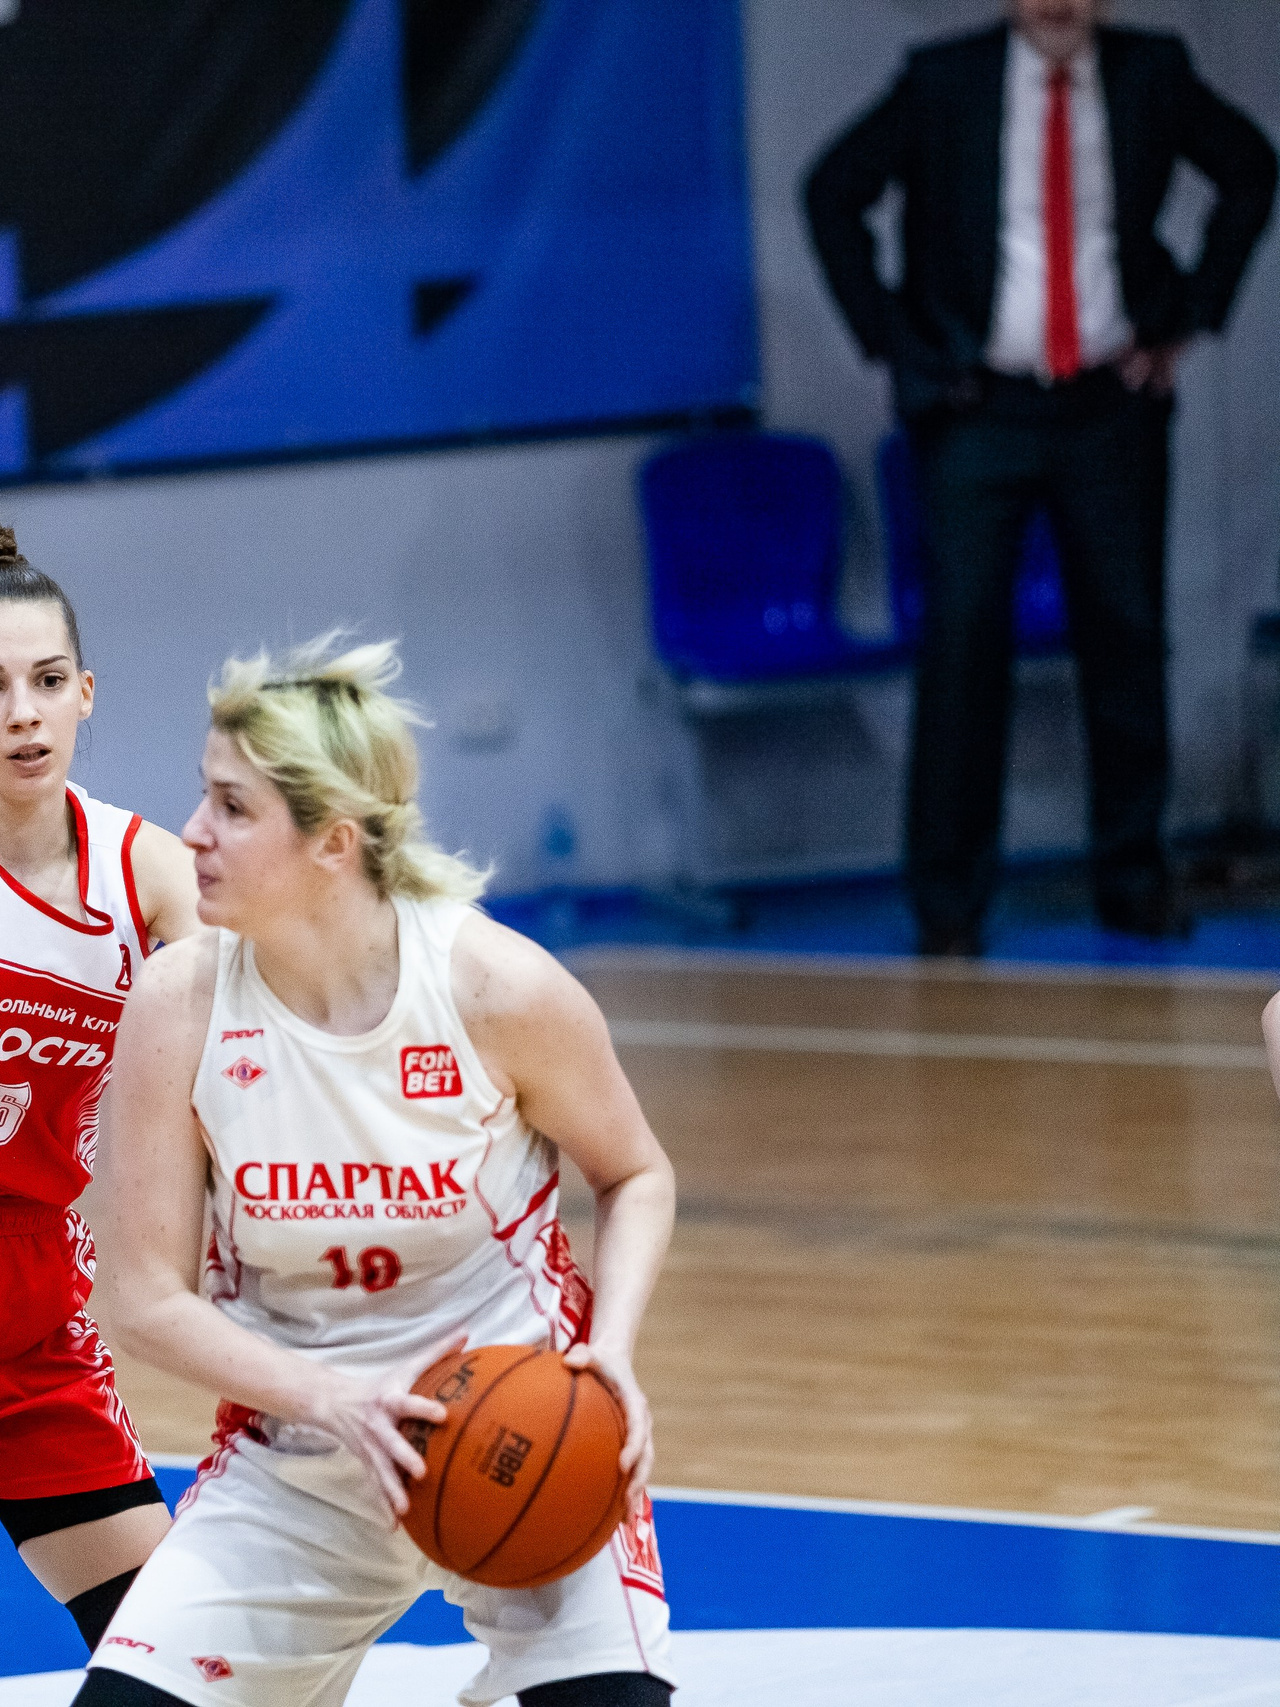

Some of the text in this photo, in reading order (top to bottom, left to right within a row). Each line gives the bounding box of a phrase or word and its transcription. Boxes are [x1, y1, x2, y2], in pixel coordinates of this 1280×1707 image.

[81, 1014, 120, 1034] КЛУ
[404, 1050, 453, 1072] FON
[405, 1070, 457, 1094] BET
[234, 1158, 466, 1201] СПАРТАК
[489, 1431, 533, 1488] FIBA
